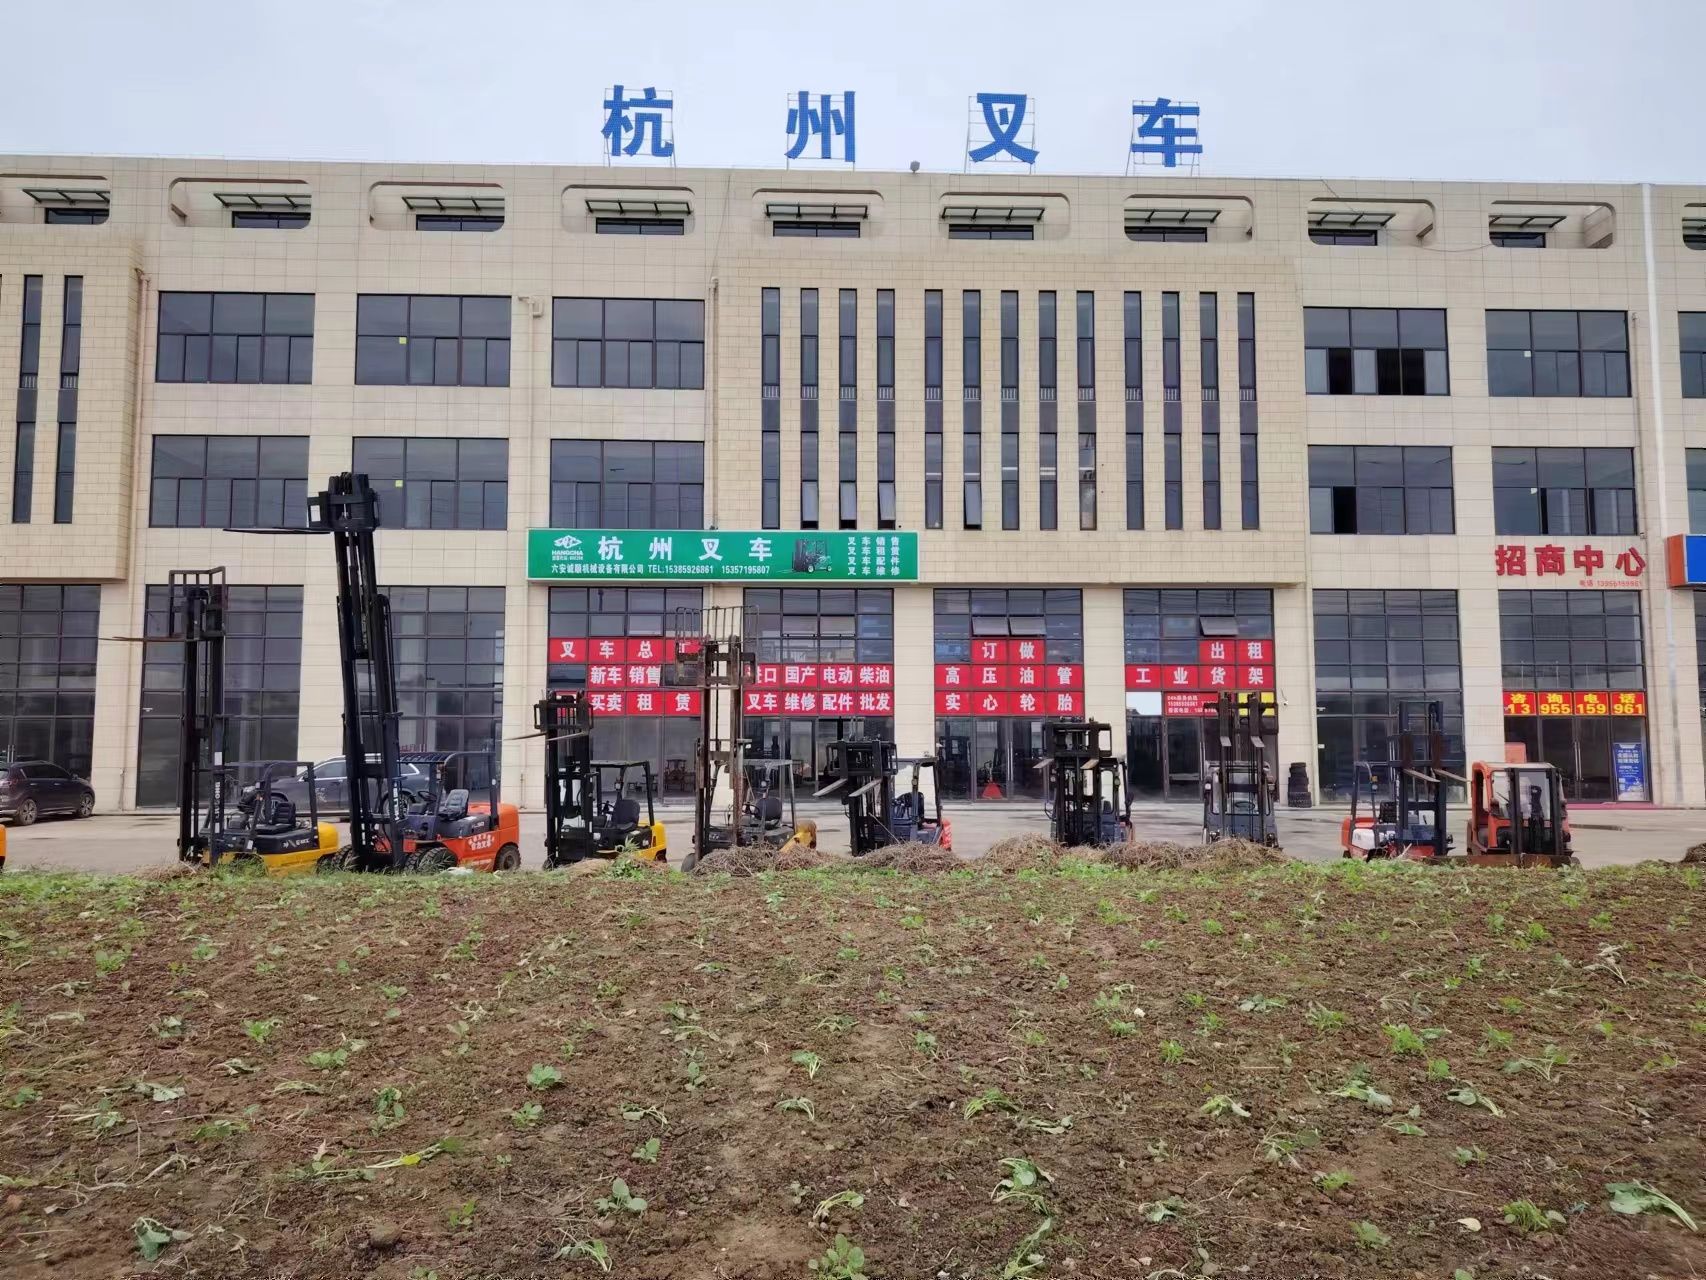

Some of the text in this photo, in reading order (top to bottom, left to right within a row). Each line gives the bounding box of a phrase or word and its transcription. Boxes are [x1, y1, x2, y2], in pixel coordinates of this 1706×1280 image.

[601, 85, 1203, 168] 杭州叉车
[598, 536, 772, 561] 杭州叉车
[847, 536, 900, 546] 叉车销售
[847, 546, 900, 556] 叉车租赁
[847, 556, 900, 566] 叉车配件
[1495, 543, 1647, 578] 招商中心
[847, 566, 900, 576] 叉车维修
[982, 641, 1035, 660] 订做
[1210, 641, 1264, 660] 出租
[945, 667, 1073, 685] 高压油管
[1136, 667, 1264, 685] 工业货架
[945, 693, 1073, 712] 实心轮胎
[1511, 693, 1637, 704] 咨询电话
